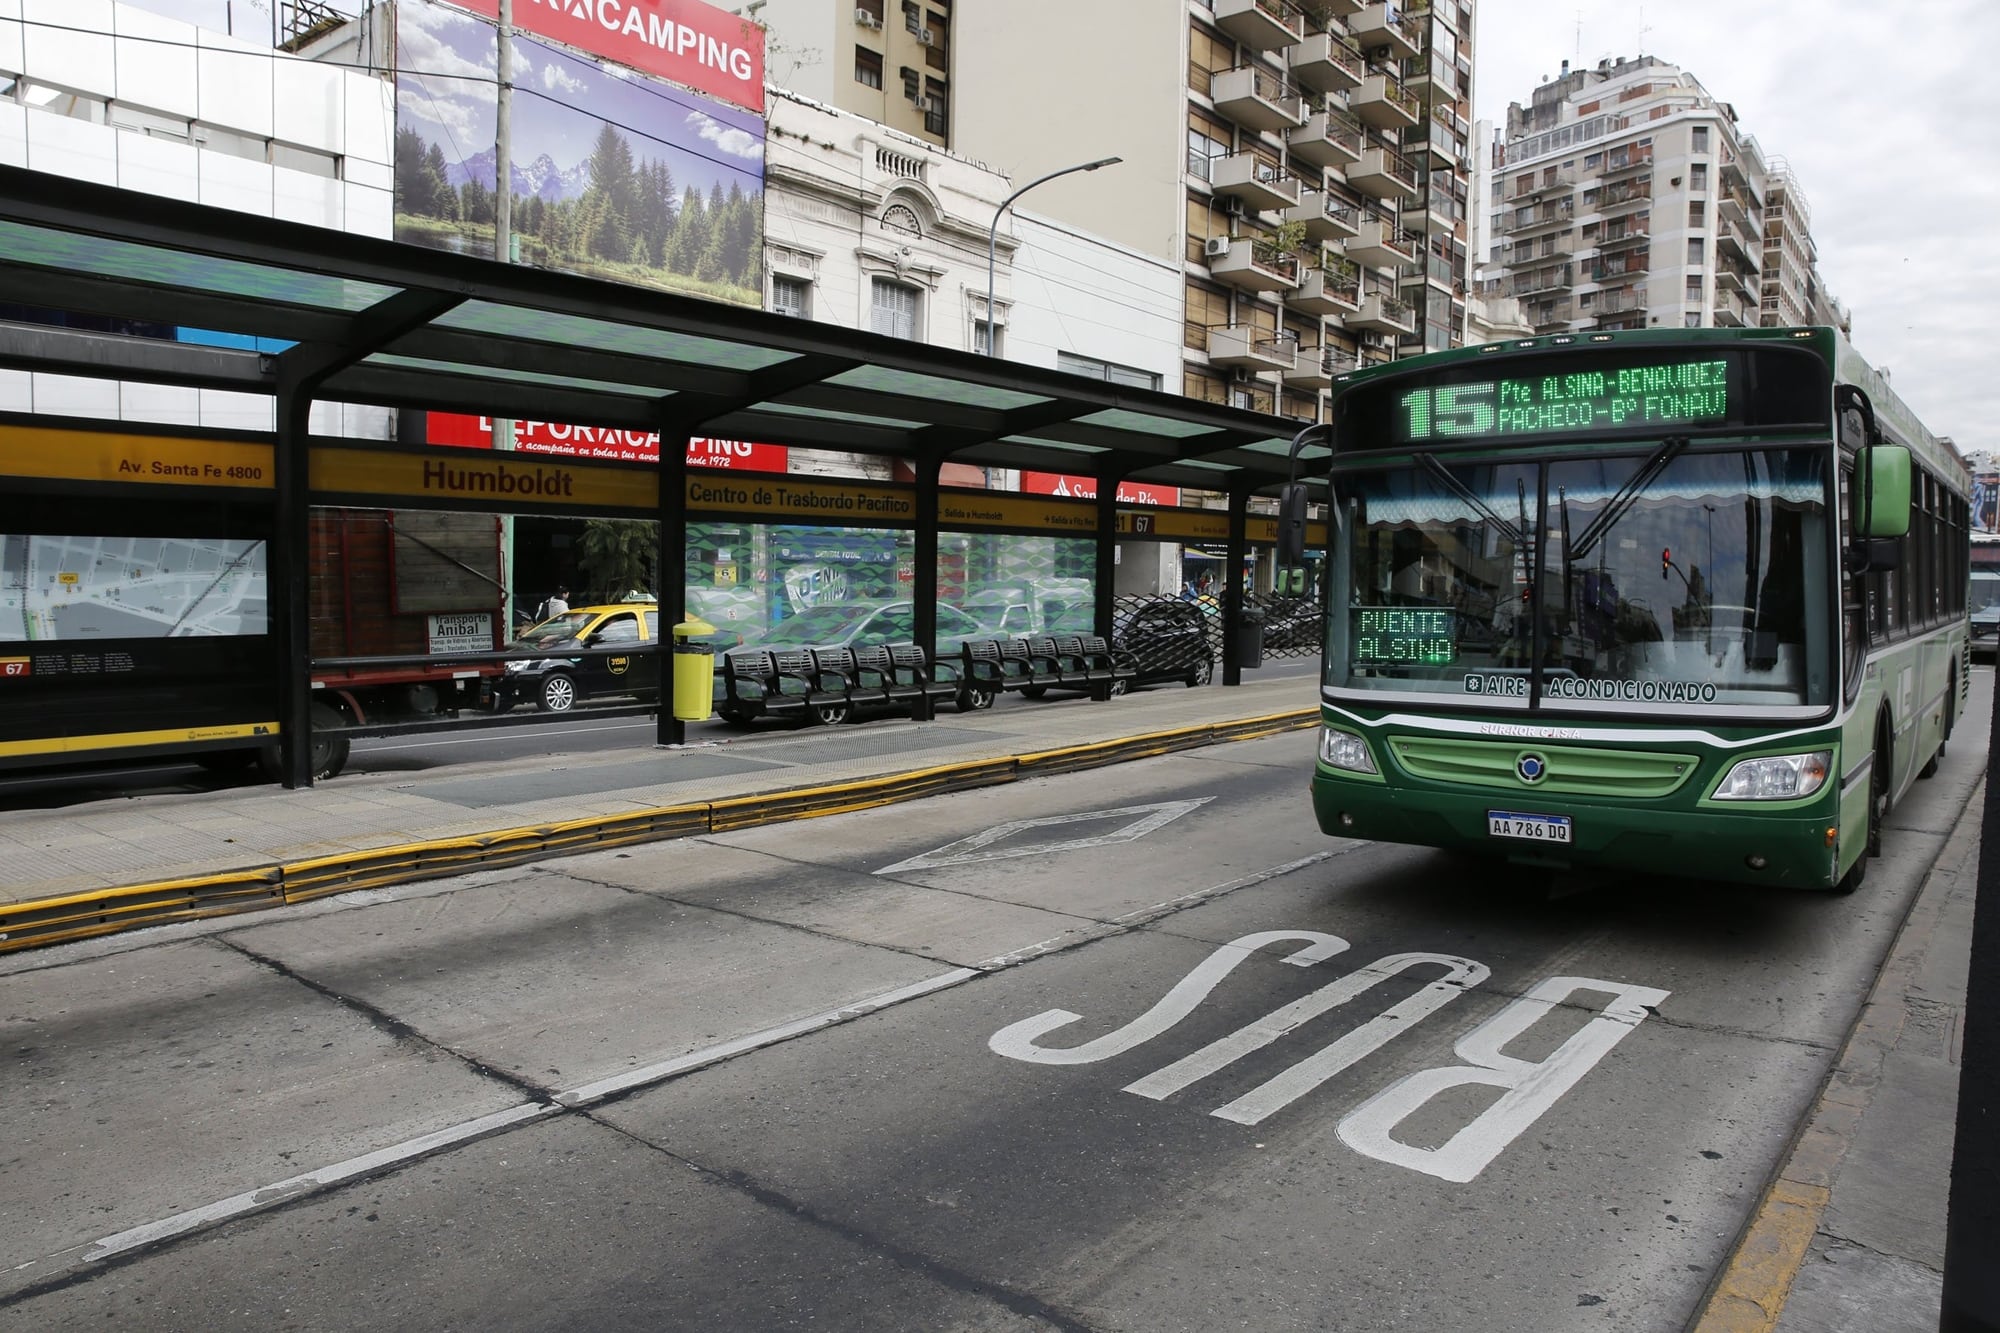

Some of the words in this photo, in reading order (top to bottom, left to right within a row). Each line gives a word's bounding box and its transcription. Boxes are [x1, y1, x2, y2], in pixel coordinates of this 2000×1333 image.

[1501, 381, 1531, 404] Pte
[1401, 383, 1494, 439] 15
[525, 442, 575, 455] acompaña
[578, 447, 590, 456] en
[593, 445, 618, 459] todas
[621, 450, 635, 460] tus
[709, 455, 731, 467] 1972
[118, 459, 146, 474] Av.
[151, 461, 199, 477] Santa
[203, 464, 222, 478] Fe
[226, 466, 262, 480] 4800
[423, 460, 573, 496] Humboldt
[689, 483, 748, 504] Centro
[752, 487, 772, 505] de
[776, 488, 854, 510] Trasbordo
[1138, 491, 1158, 505] Río
[1136, 516, 1149, 533] 67
[436, 614, 488, 624] Transporte
[437, 623, 479, 636] Anibal
[1361, 611, 1446, 632] PUENTE
[1359, 637, 1451, 661] ALSINA
[6, 663, 23, 675] 67
[1486, 677, 1526, 696] AIRE
[1549, 678, 1718, 703] ACONDICIONADO
[1493, 820, 1511, 834] AA
[1515, 821, 1543, 837] 786
[1548, 824, 1567, 840] DQ
[987, 929, 1671, 1184] BUS
